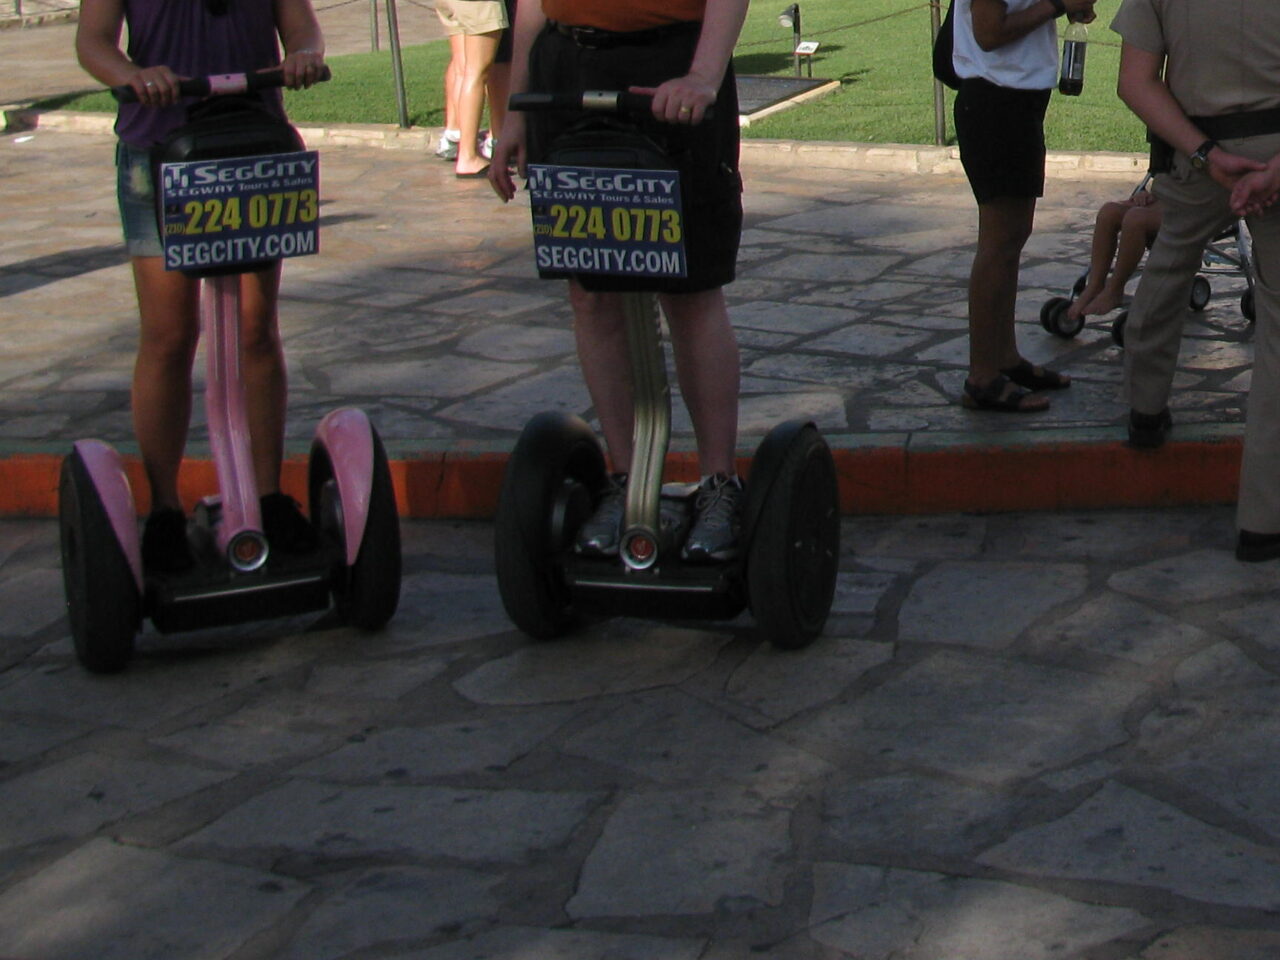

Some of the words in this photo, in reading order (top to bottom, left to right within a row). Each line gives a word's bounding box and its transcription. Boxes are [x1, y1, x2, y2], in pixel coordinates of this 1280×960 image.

[167, 184, 235, 198] SEGWAY
[239, 182, 268, 191] Tours
[271, 179, 280, 188] &
[283, 177, 313, 187] Sales
[532, 190, 597, 201] SEGWAY
[601, 193, 630, 203] Tours
[632, 195, 641, 204] &
[644, 195, 674, 205] Sales
[184, 197, 242, 235] 224
[248, 189, 318, 228] 0773
[550, 204, 606, 239] 224
[612, 207, 682, 243] 0773
[167, 230, 315, 268] SEGCITY.COM
[537, 245, 681, 274] SEGCITY.COM
